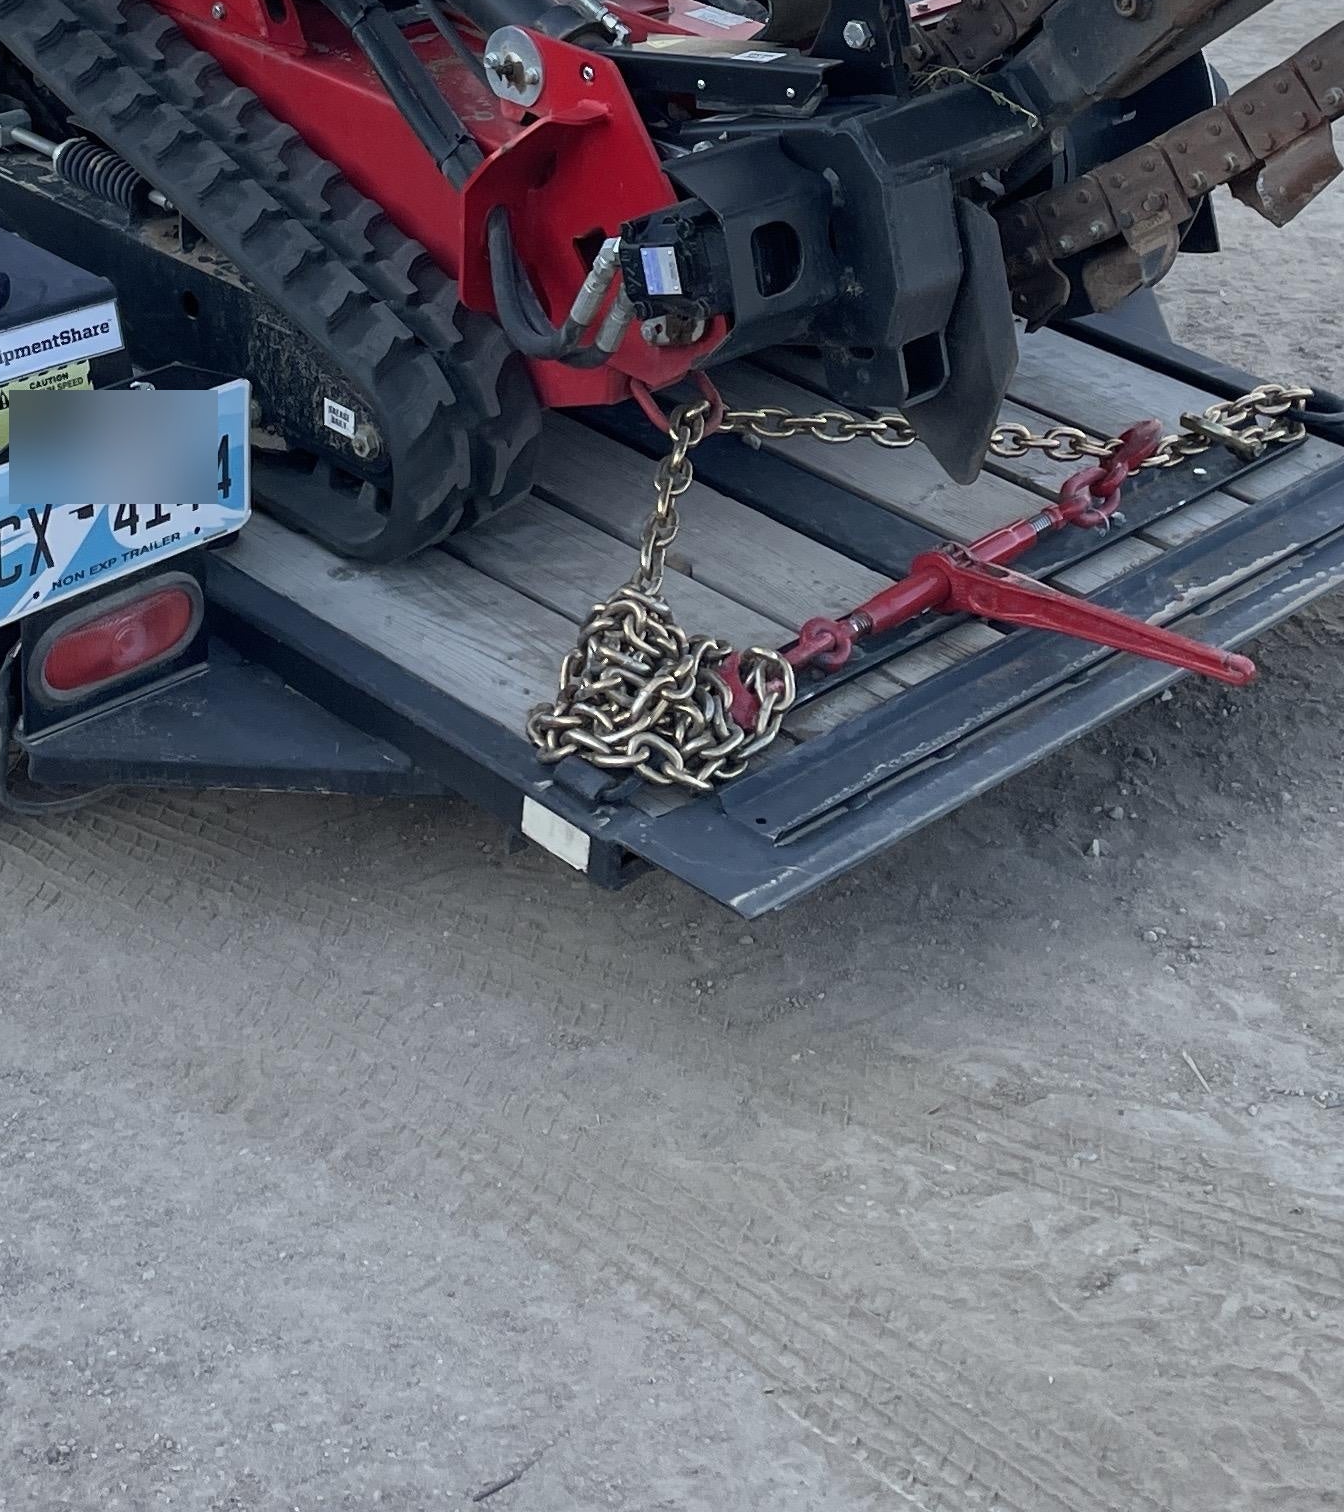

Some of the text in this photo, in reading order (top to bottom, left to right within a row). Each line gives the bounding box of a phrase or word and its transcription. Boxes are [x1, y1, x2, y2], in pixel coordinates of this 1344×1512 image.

[29, 372, 69, 390] CAUTION
[51, 531, 181, 592] NON EXP TRAILER
